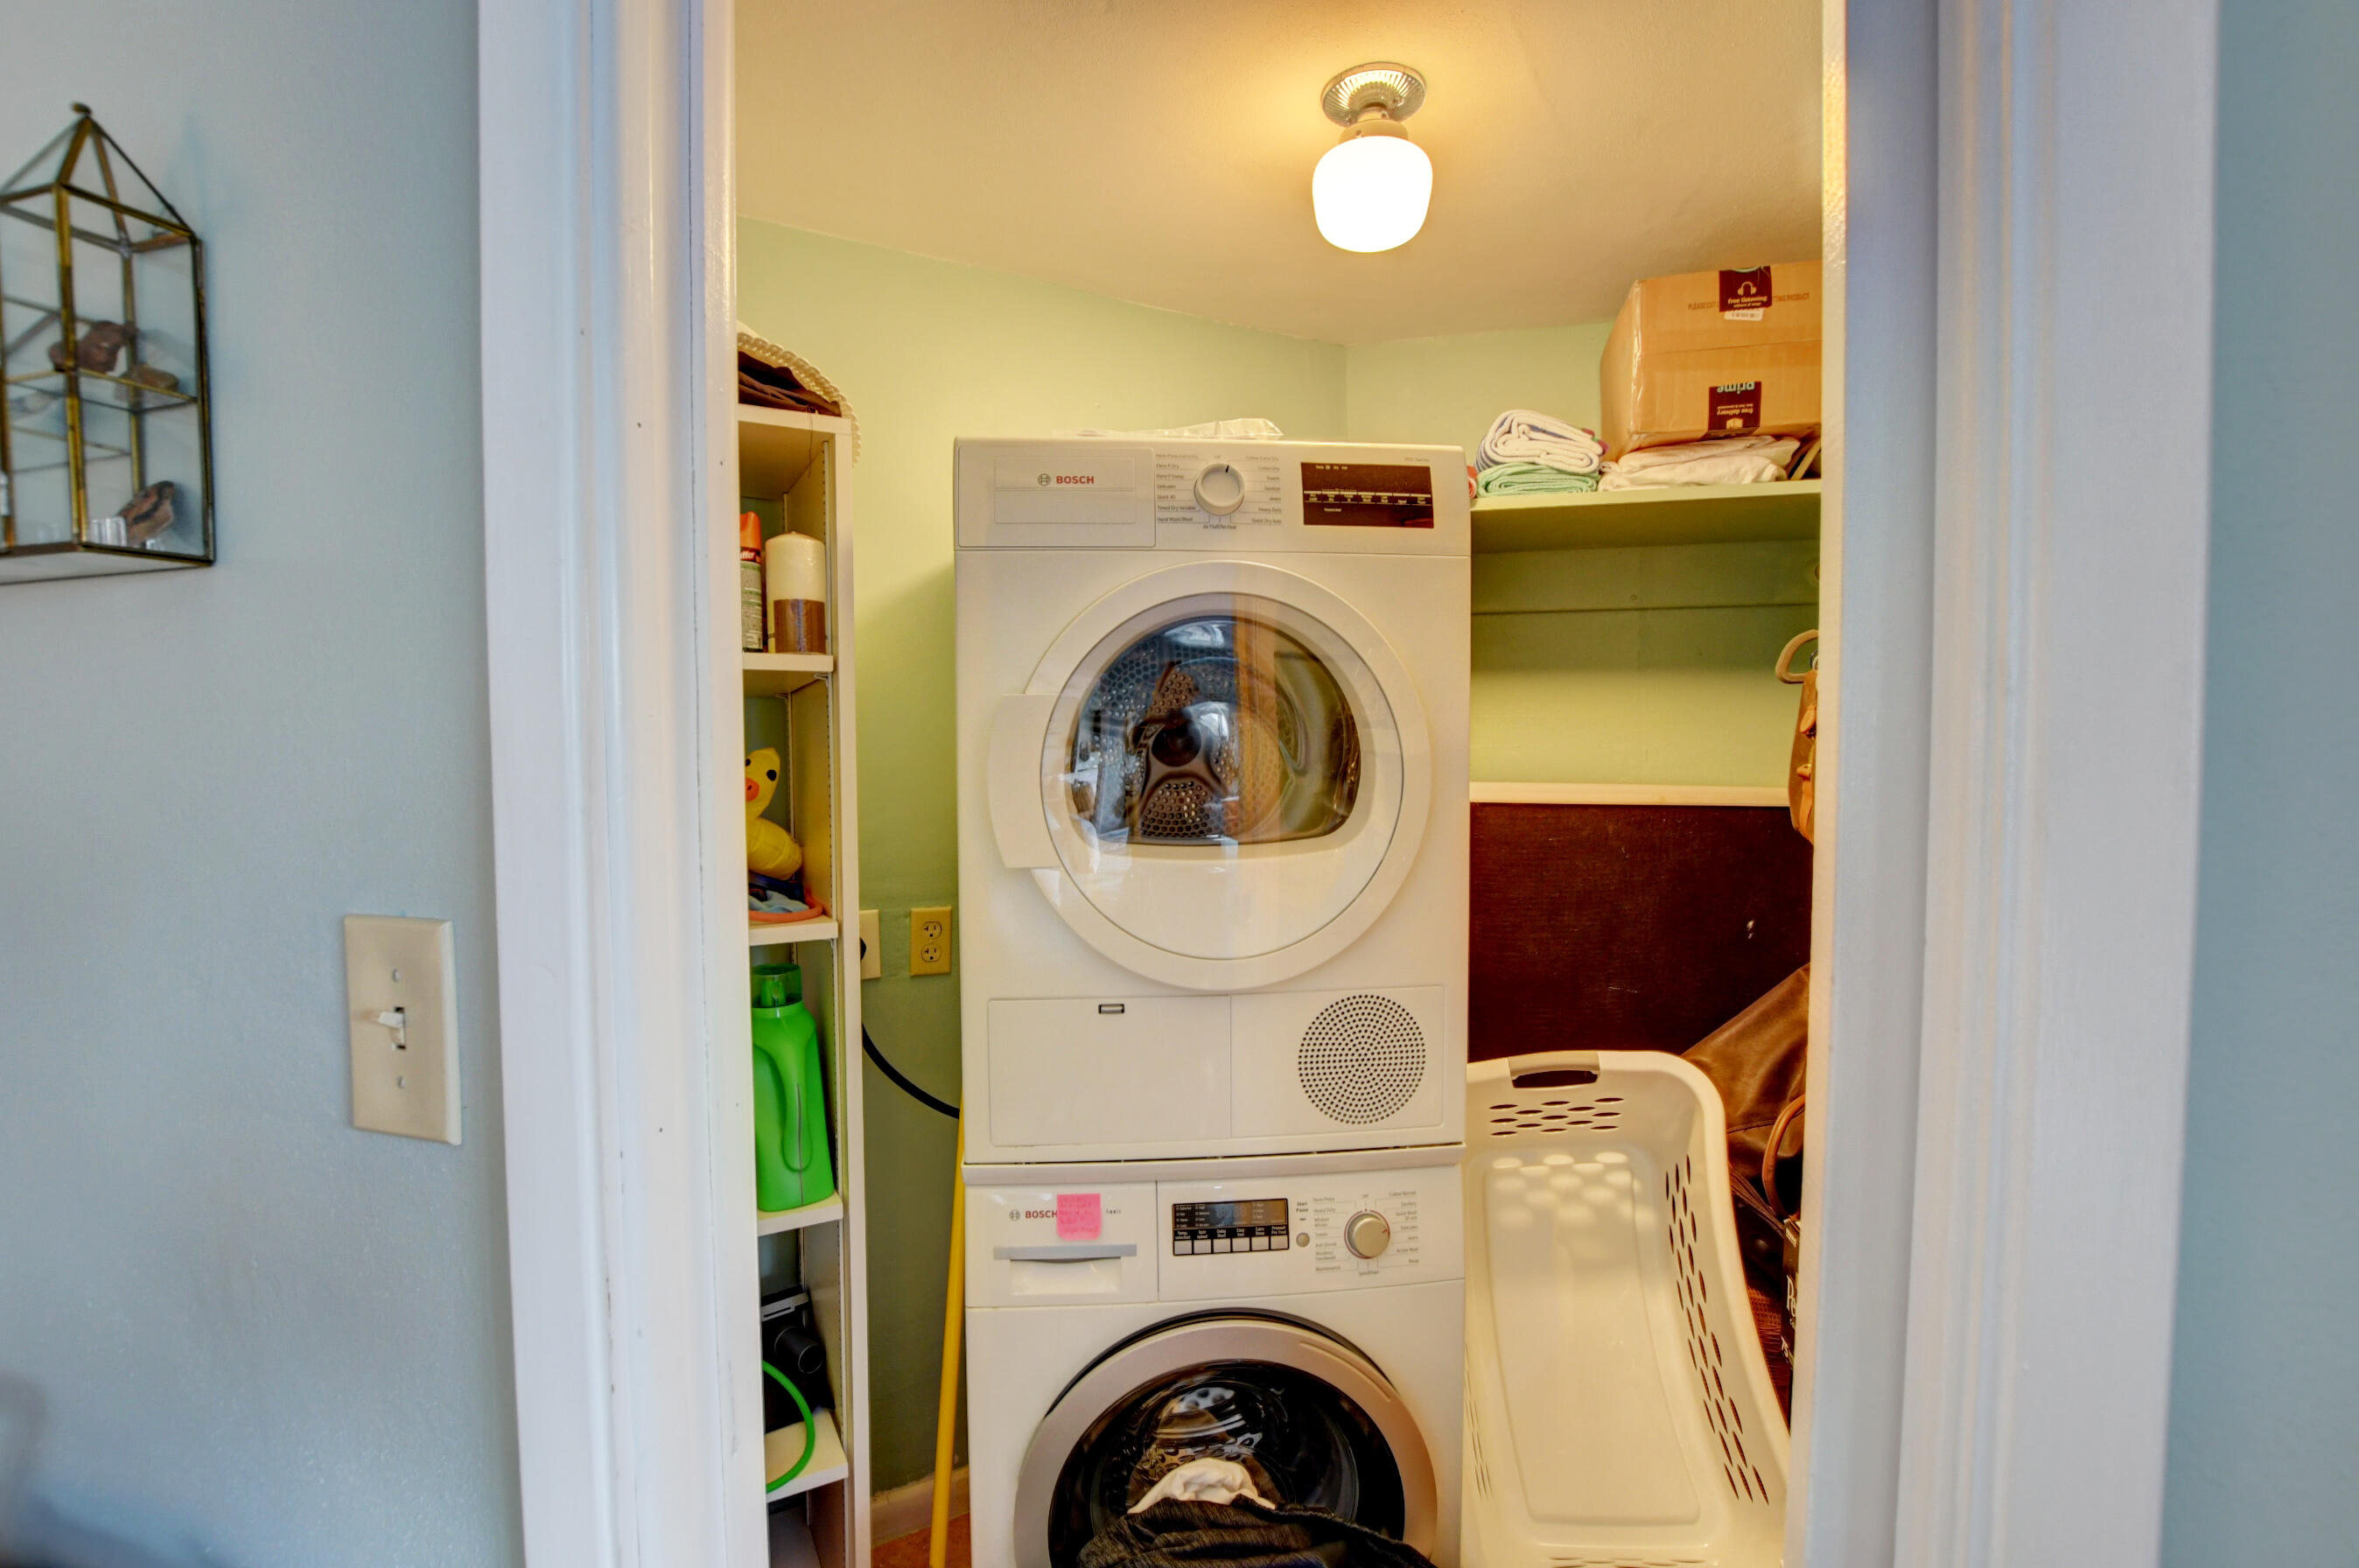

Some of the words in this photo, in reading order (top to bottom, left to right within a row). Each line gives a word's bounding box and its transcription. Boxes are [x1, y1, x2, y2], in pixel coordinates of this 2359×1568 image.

[1717, 382, 1755, 395] prime
[1056, 475, 1095, 485] BOSCH
[1025, 1210, 1058, 1219] BOSCH
